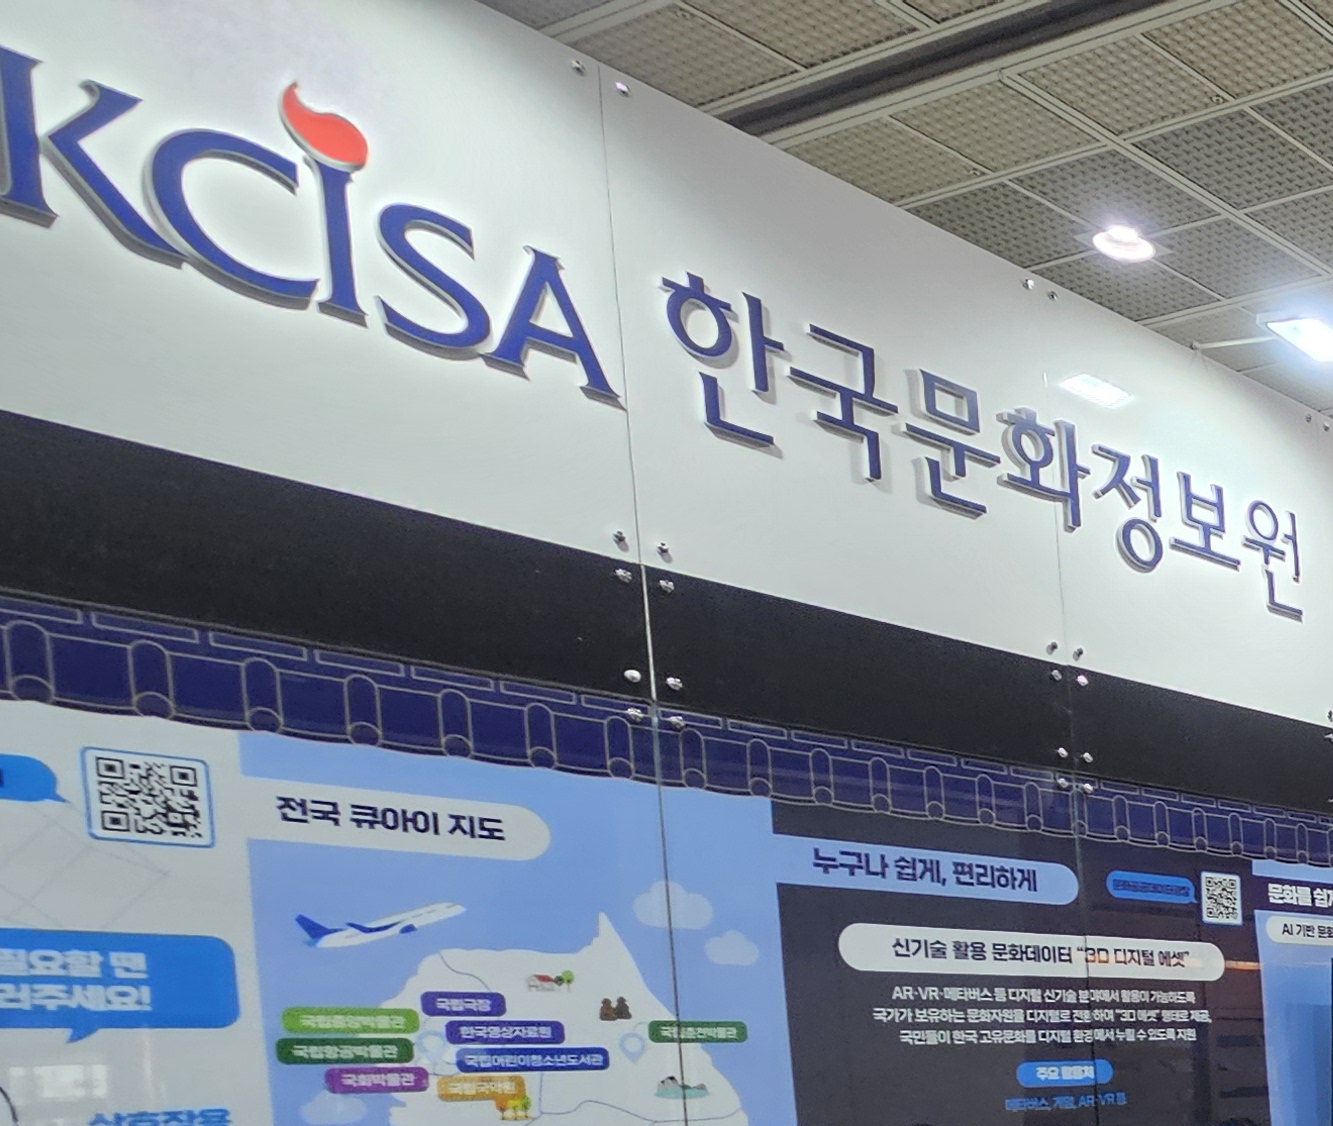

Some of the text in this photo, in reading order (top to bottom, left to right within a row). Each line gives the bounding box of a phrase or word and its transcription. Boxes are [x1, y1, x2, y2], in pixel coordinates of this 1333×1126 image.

[0, 45, 626, 410] KCISA
[661, 271, 1304, 623] 한국문화정보원
[277, 795, 506, 842] 전국 큐아이 지도
[812, 847, 1038, 893] 누구나 쉽게, 편리하게
[1267, 882, 1312, 907] 문화를
[1281, 925, 1293, 936] AI
[1296, 925, 1316, 938] 기반
[892, 938, 947, 960] 신기술
[952, 939, 987, 962] 활용
[991, 942, 1073, 965] 문화데이터
[1113, 948, 1155, 967] 디지털
[1008, 987, 1042, 1003] 디지털
[1043, 989, 1077, 1003] 신기술
[872, 1007, 913, 1023] 국가가
[914, 1007, 965, 1023] 보유하는
[967, 1008, 1024, 1023] 문화자원을
[1026, 1009, 1072, 1023] 디지털로
[459, 1025, 553, 1039] 한국영상자료원
[899, 1029, 950, 1045] 국민들이
[951, 1029, 978, 1044] 한국
[979, 1029, 1036, 1044] 고유문화를
[1038, 1029, 1071, 1043] 디지털
[1136, 1028, 1147, 1041] 수
[1177, 1028, 1197, 1041] 지원
[463, 1051, 604, 1069] 국립어린이청소년도서관
[1036, 1065, 1060, 1081] 주요
